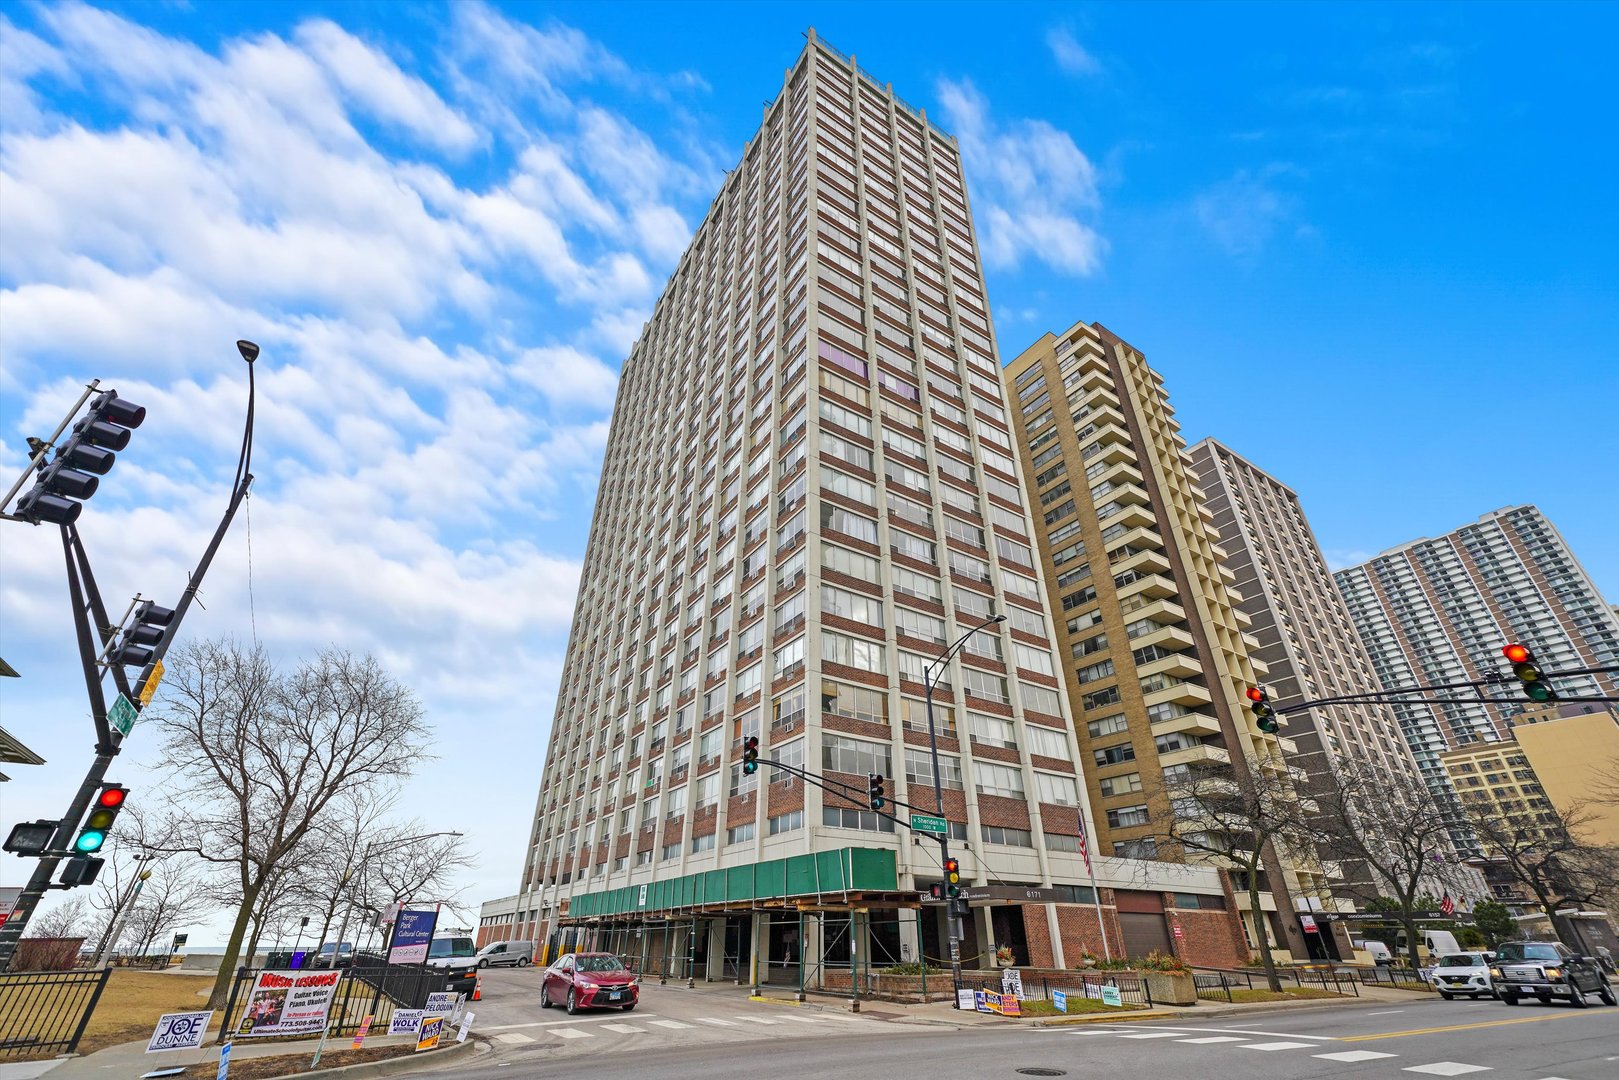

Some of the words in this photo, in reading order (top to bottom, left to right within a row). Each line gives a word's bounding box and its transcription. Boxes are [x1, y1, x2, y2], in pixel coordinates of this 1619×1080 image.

[918, 818, 939, 826] Sheridan
[403, 914, 418, 922] Berger
[160, 1018, 204, 1036] JOE
[156, 1034, 197, 1044] DUNNE
